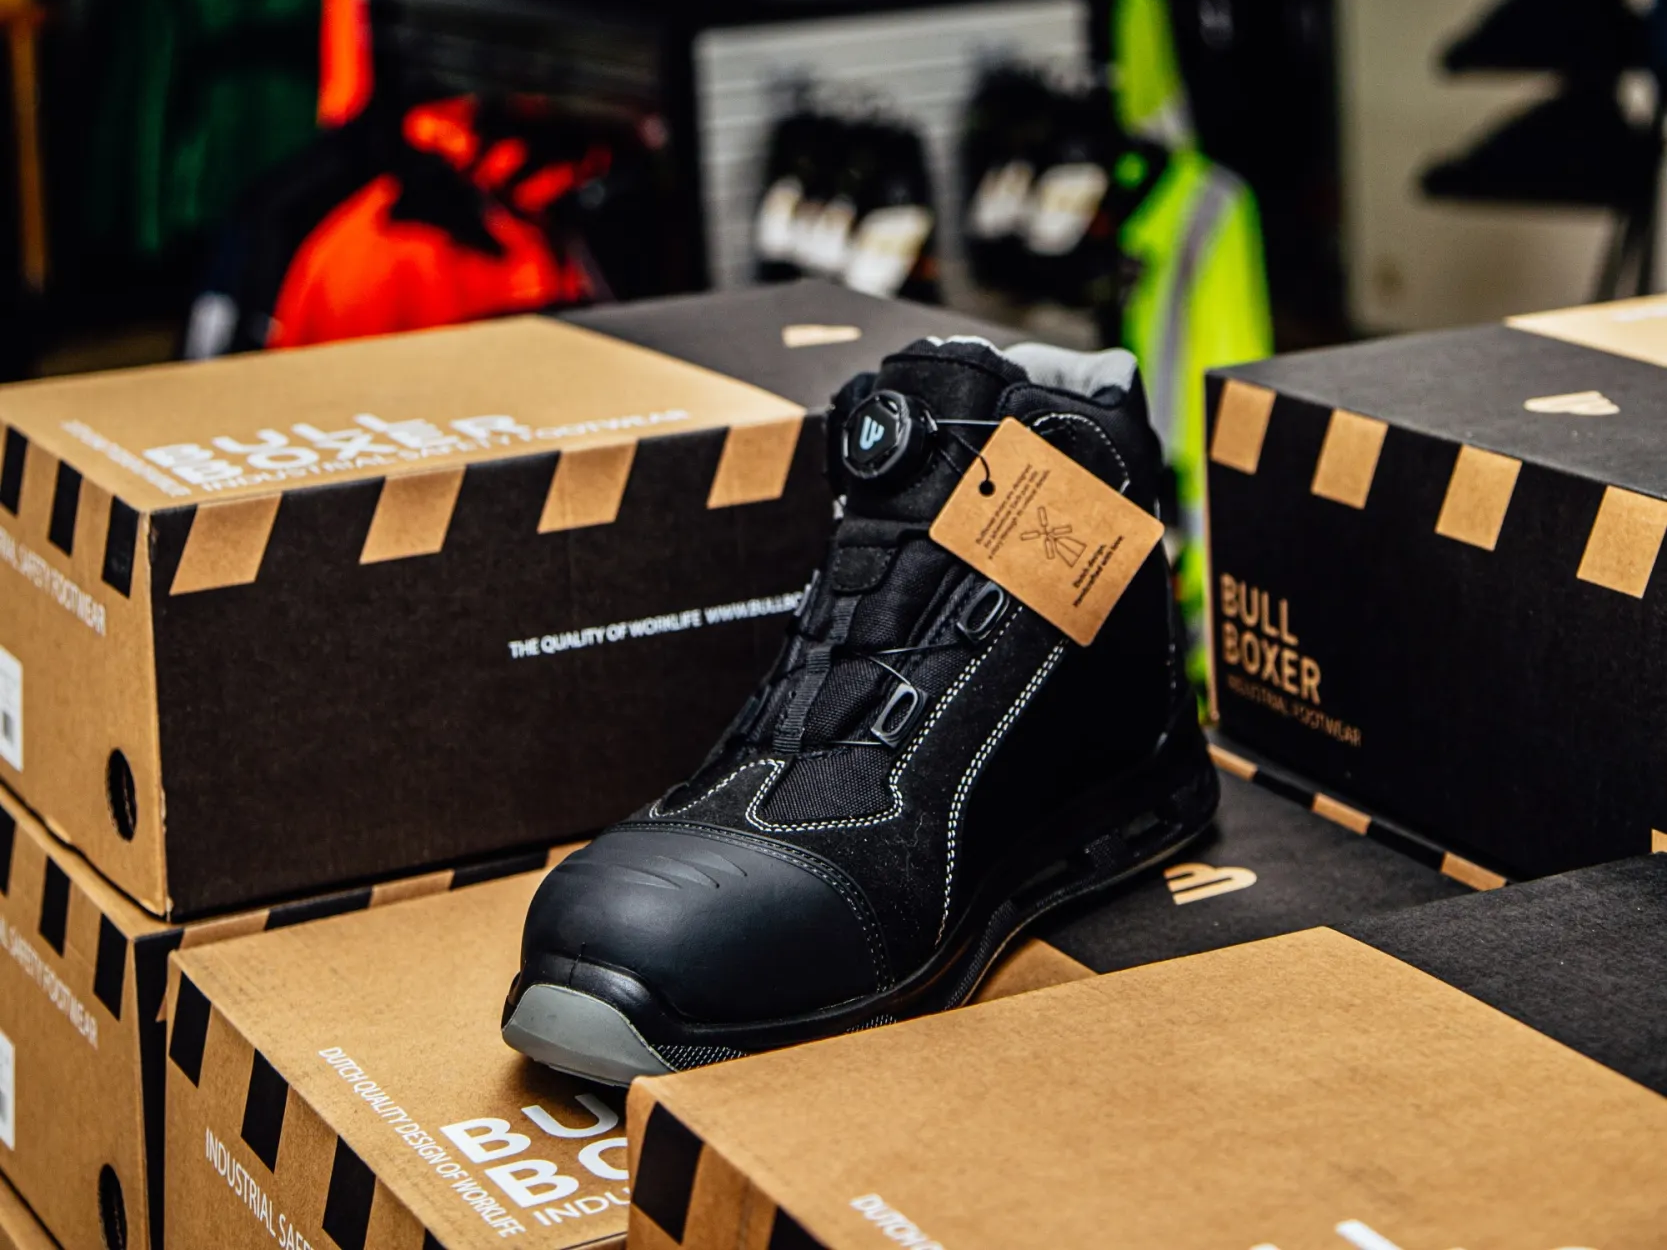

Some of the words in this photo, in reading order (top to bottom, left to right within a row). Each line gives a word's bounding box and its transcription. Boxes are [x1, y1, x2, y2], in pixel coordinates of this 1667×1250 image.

[508, 639, 541, 659] THE
[540, 625, 606, 654] QUALITY
[606, 622, 629, 642] OF
[627, 608, 703, 638] WORKLIFE
[1220, 572, 1299, 646] BULL
[1222, 620, 1322, 706] BOXER
[318, 1046, 368, 1083] DUTCH
[353, 1077, 413, 1124] QUALITY
[395, 1121, 451, 1165] DESIGN
[439, 1093, 620, 1164] BU
[205, 1126, 277, 1238] INDUSTRIAL
[435, 1161, 470, 1180] OF
[450, 1176, 527, 1239] WORKLIFE
[848, 1192, 929, 1247] DUTCH
